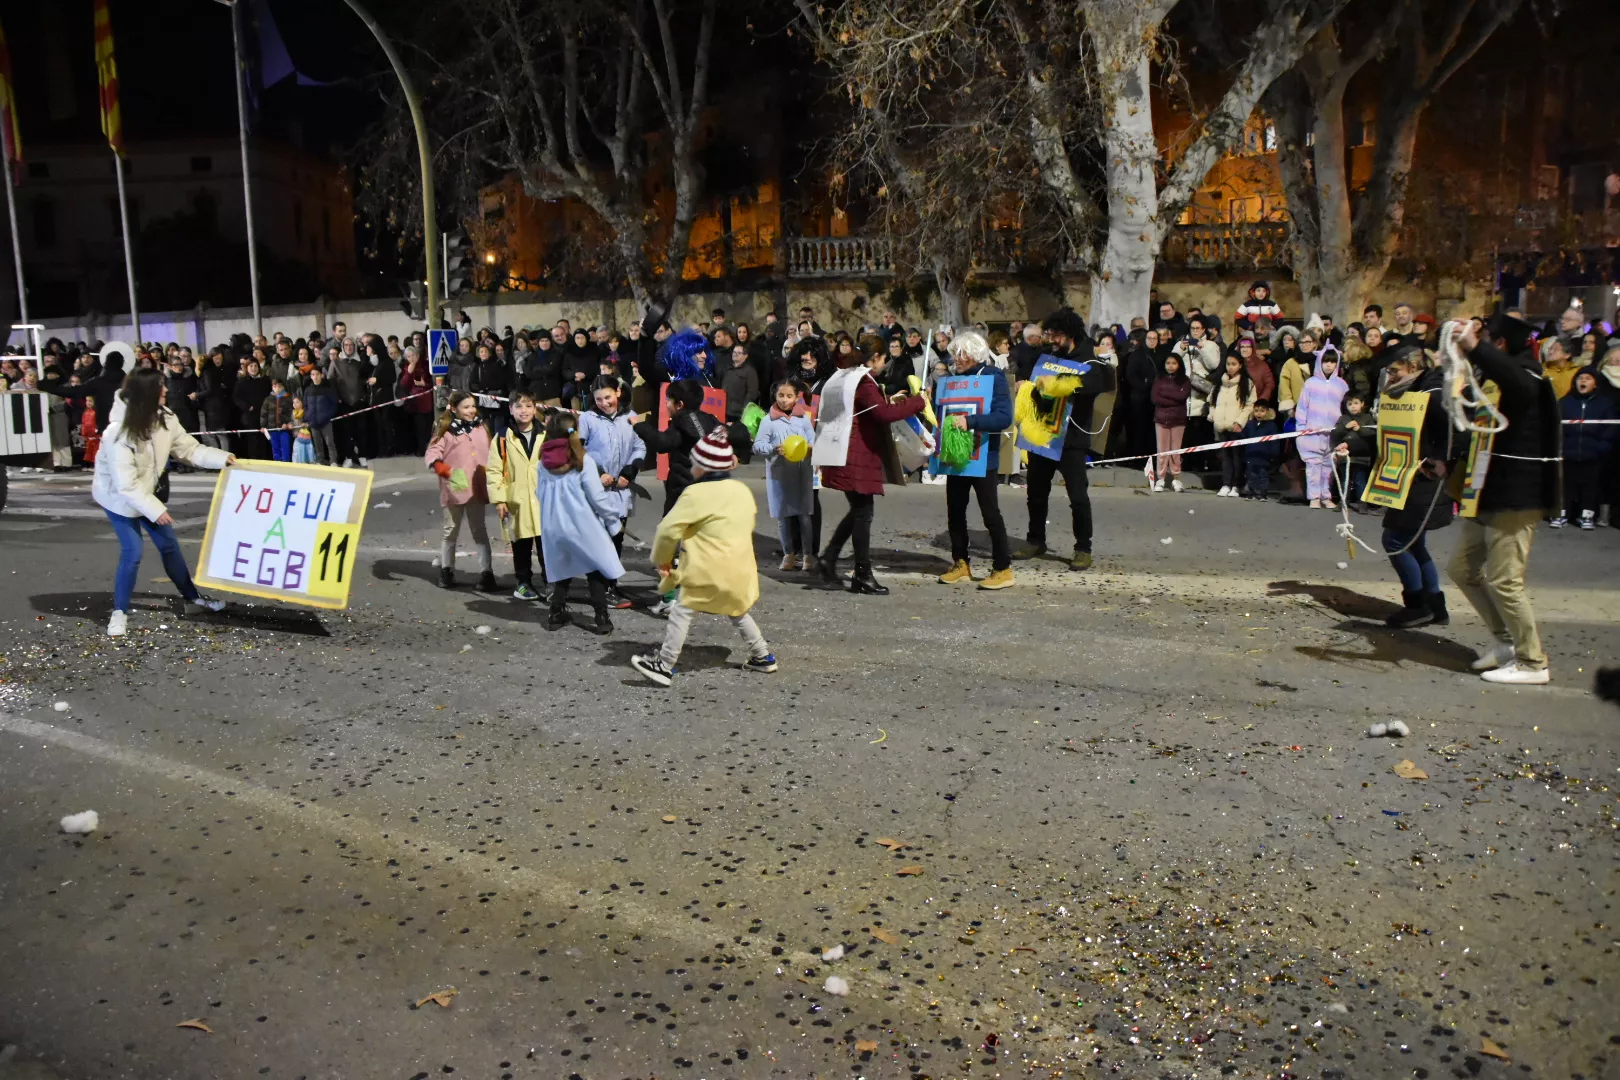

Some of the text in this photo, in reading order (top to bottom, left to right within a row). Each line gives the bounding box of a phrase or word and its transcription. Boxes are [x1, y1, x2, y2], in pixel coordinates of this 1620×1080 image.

[973, 380, 979, 388] 6
[235, 484, 274, 513] YO
[263, 517, 286, 549] A
[232, 541, 306, 589] EGB
[319, 532, 350, 583] 11
